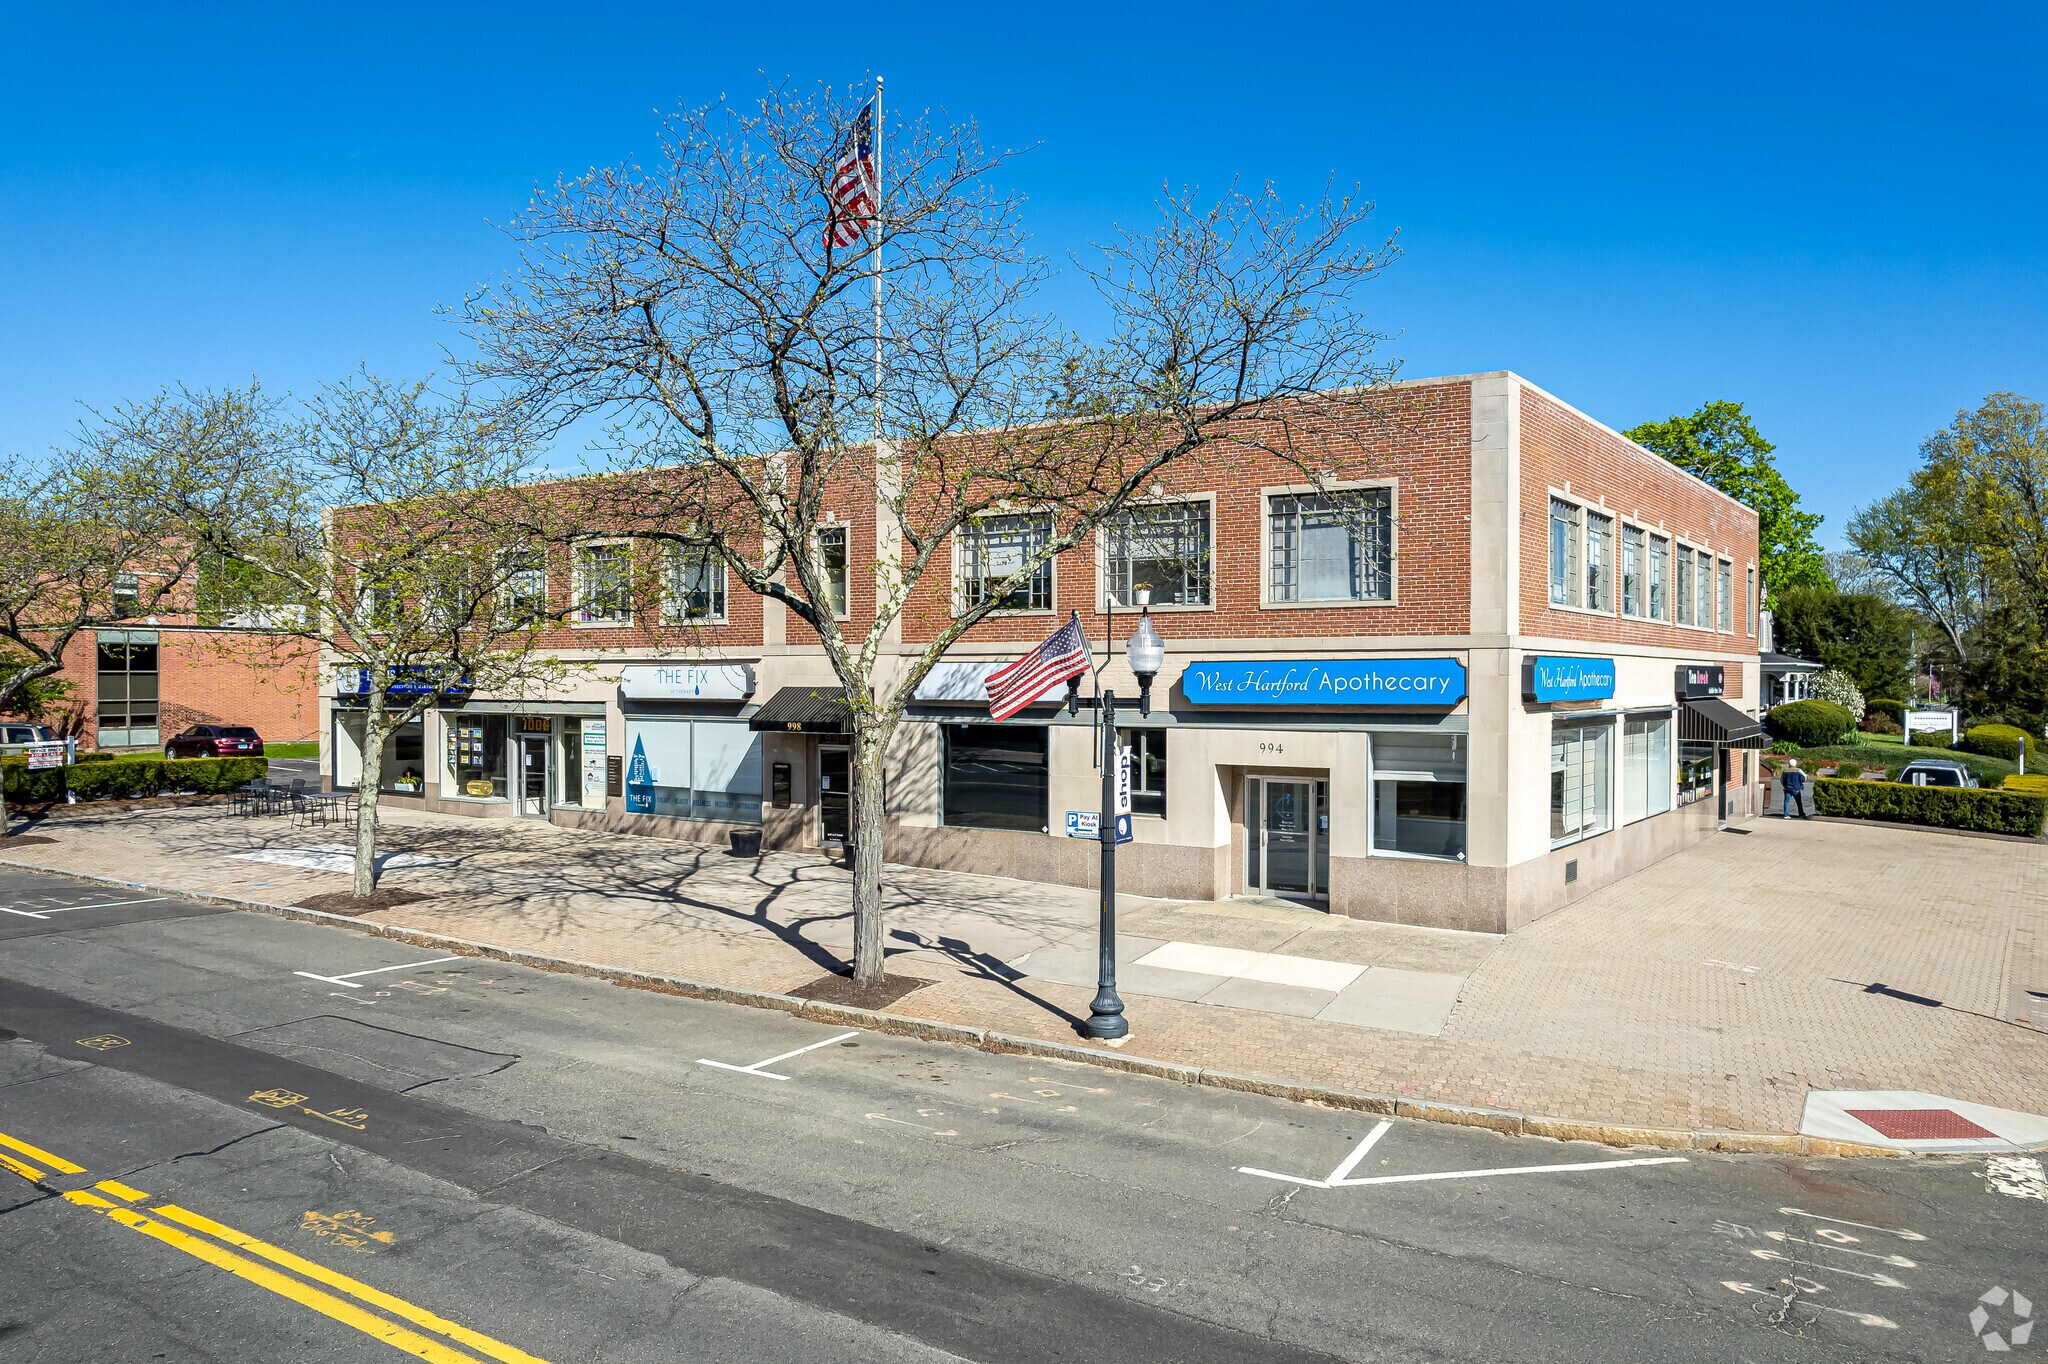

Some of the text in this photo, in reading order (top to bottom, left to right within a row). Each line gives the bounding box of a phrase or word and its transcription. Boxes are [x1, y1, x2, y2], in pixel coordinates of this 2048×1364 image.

[657, 669, 708, 684] THE FIX
[1195, 667, 1451, 698] West Hartford Apothecary
[1539, 665, 1613, 694] West Hartford Apothecary
[787, 721, 802, 731] 998
[1259, 742, 1284, 754] 994
[1119, 755, 1130, 808] shop
[630, 794, 652, 803] THE FIX
[1080, 814, 1091, 822] Pay
